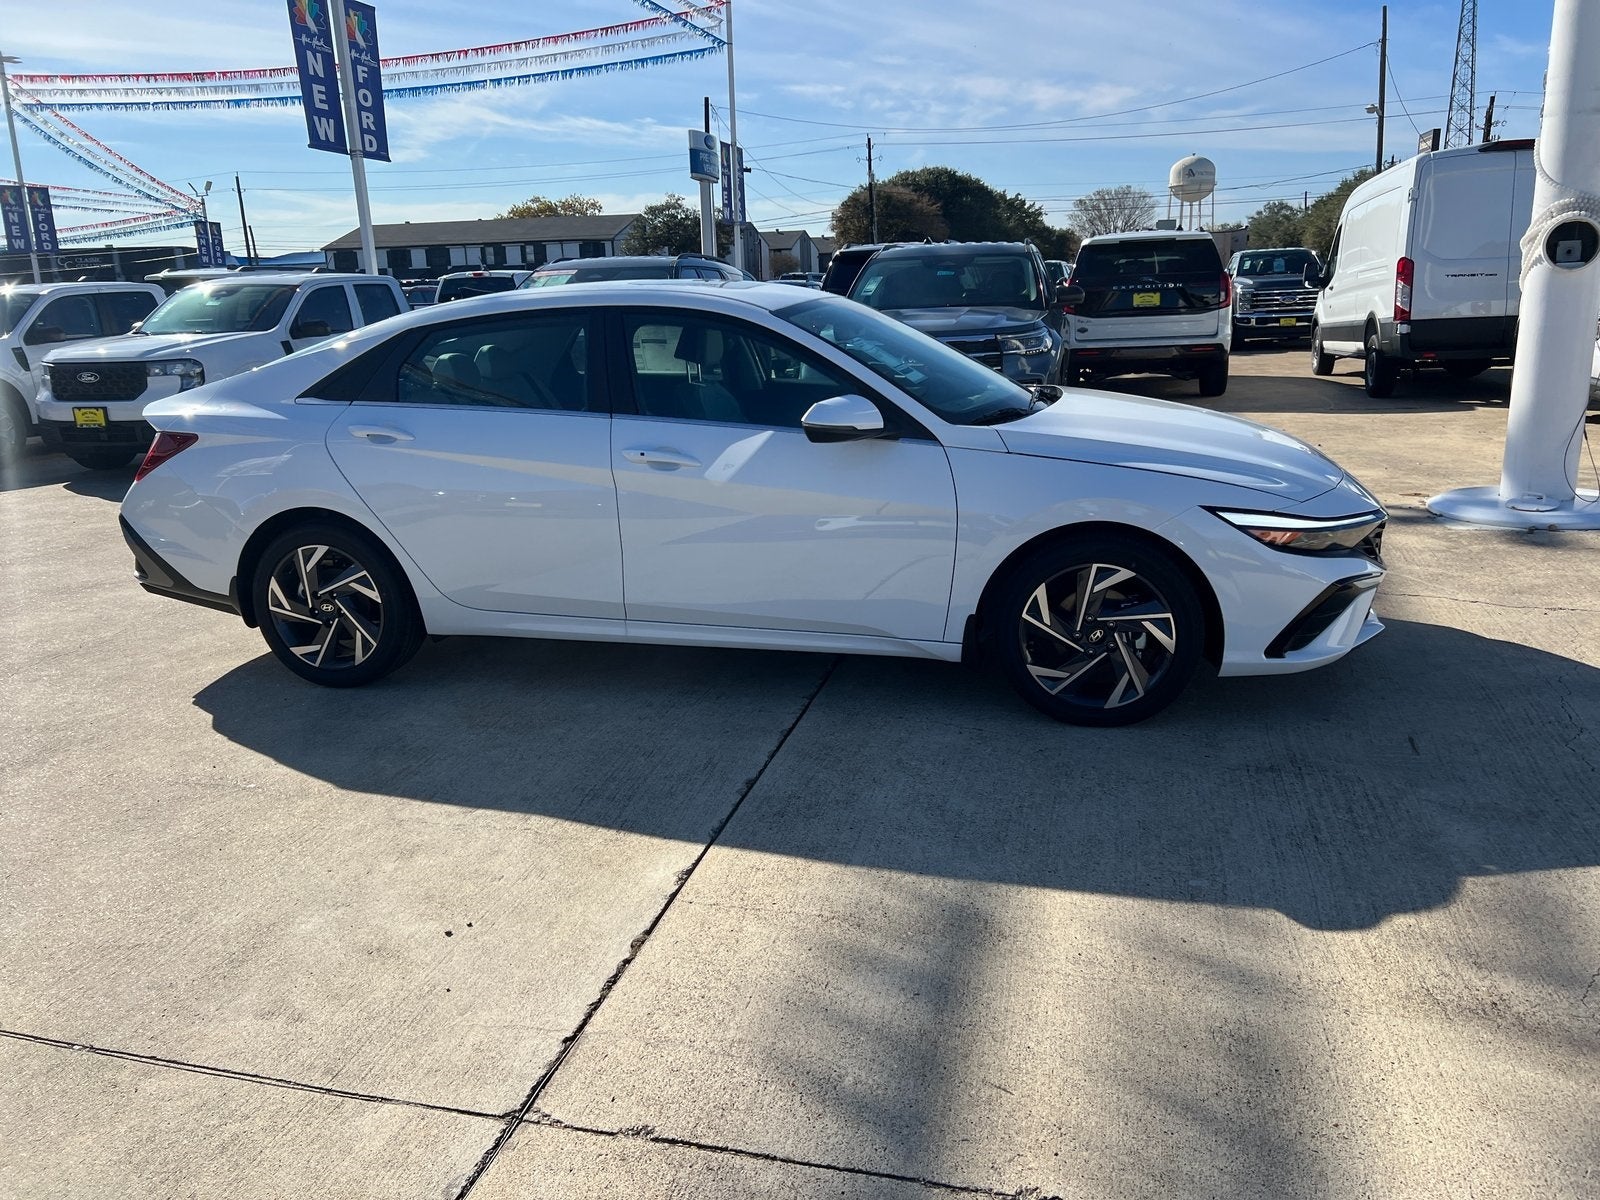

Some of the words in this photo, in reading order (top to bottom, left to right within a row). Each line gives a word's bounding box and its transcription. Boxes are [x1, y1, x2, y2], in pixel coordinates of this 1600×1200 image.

[306, 50, 335, 143] NEW
[356, 65, 378, 152] FORD
[8, 212, 25, 250] NEW
[38, 213, 52, 250] FORD
